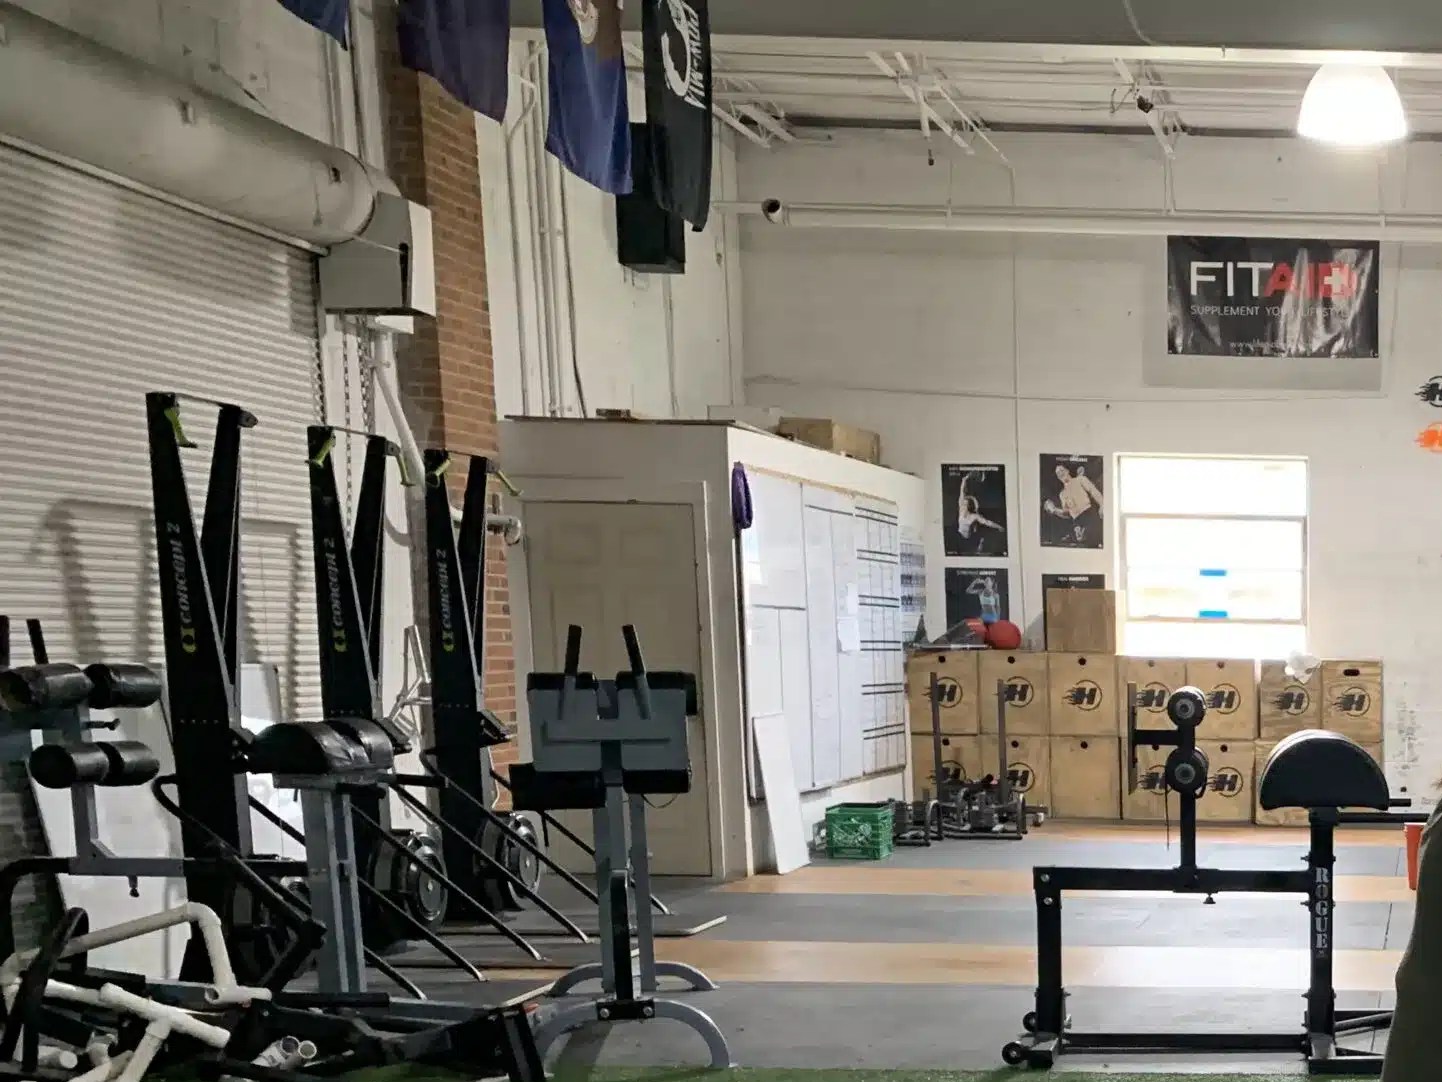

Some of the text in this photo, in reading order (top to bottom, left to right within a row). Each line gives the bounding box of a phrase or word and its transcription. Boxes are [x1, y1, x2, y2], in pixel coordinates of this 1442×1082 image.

[1190, 261, 1358, 298] FITAID
[1190, 305, 1260, 316] SUPPLEMENT
[1315, 867, 1329, 948] ROGUE
